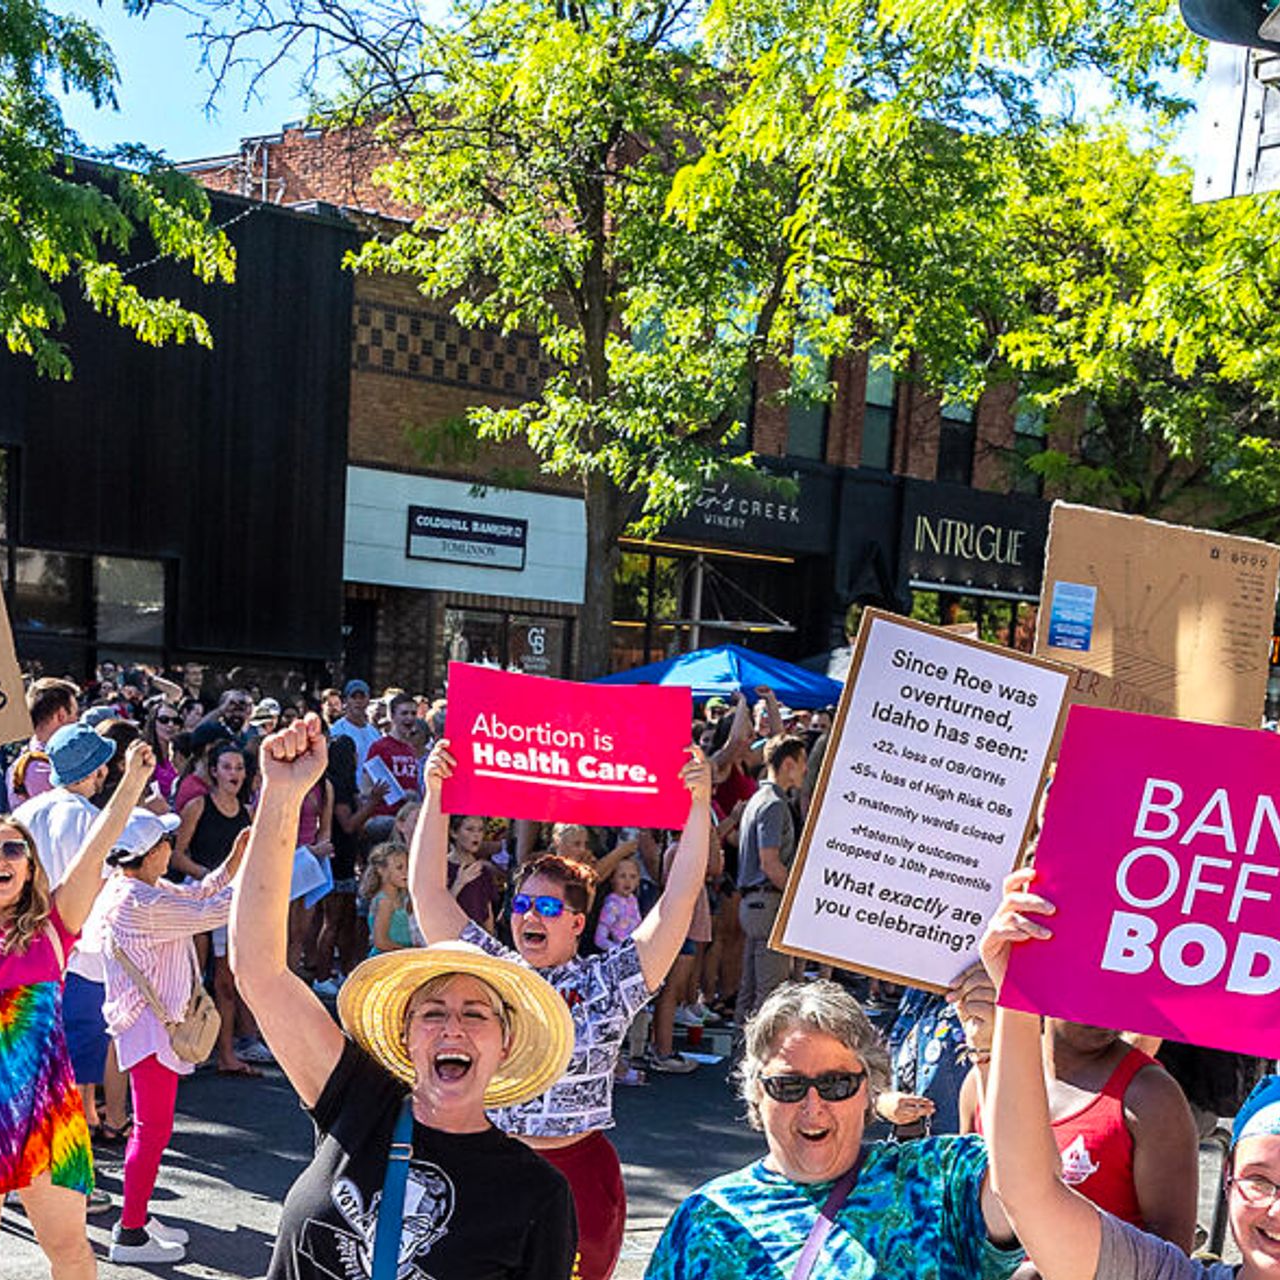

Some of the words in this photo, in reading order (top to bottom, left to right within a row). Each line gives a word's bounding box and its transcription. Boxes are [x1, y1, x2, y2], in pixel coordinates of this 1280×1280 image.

[703, 513, 747, 530] WINERY
[738, 499, 800, 525] CREEK
[913, 514, 1026, 567] INTRIGUE
[891, 649, 949, 681] Since
[952, 667, 994, 694] Roe
[998, 683, 1039, 708] was
[1072, 667, 1100, 698] ER
[471, 712, 585, 750] Abortion
[593, 728, 615, 752] is
[871, 701, 931, 734] Idaho
[934, 718, 971, 745] has
[974, 735, 1030, 763] seen:
[900, 684, 1015, 732] overturned,
[472, 742, 570, 777] Health
[577, 756, 658, 783] Care.
[901, 746, 928, 766] loss
[930, 755, 945, 768] of
[945, 758, 1007, 788] OB/GYNs
[880, 769, 907, 789] loss
[909, 776, 923, 791] of
[924, 782, 955, 804] High
[957, 791, 984, 810] Risk
[858, 797, 920, 823] maternity
[921, 814, 960, 833] wards
[962, 824, 1005, 846] closed
[826, 838, 881, 863] dropped
[883, 853, 897, 866] to
[898, 856, 927, 874] 10th
[928, 865, 993, 892] percentile
[856, 825, 916, 852] Maternity
[917, 843, 980, 869] outcomes
[823, 868, 874, 898] What
[878, 885, 949, 920] exactly
[951, 906, 983, 927] are
[1115, 846, 1279, 923] OFF
[814, 897, 851, 918] you
[855, 905, 976, 953] celebrating?
